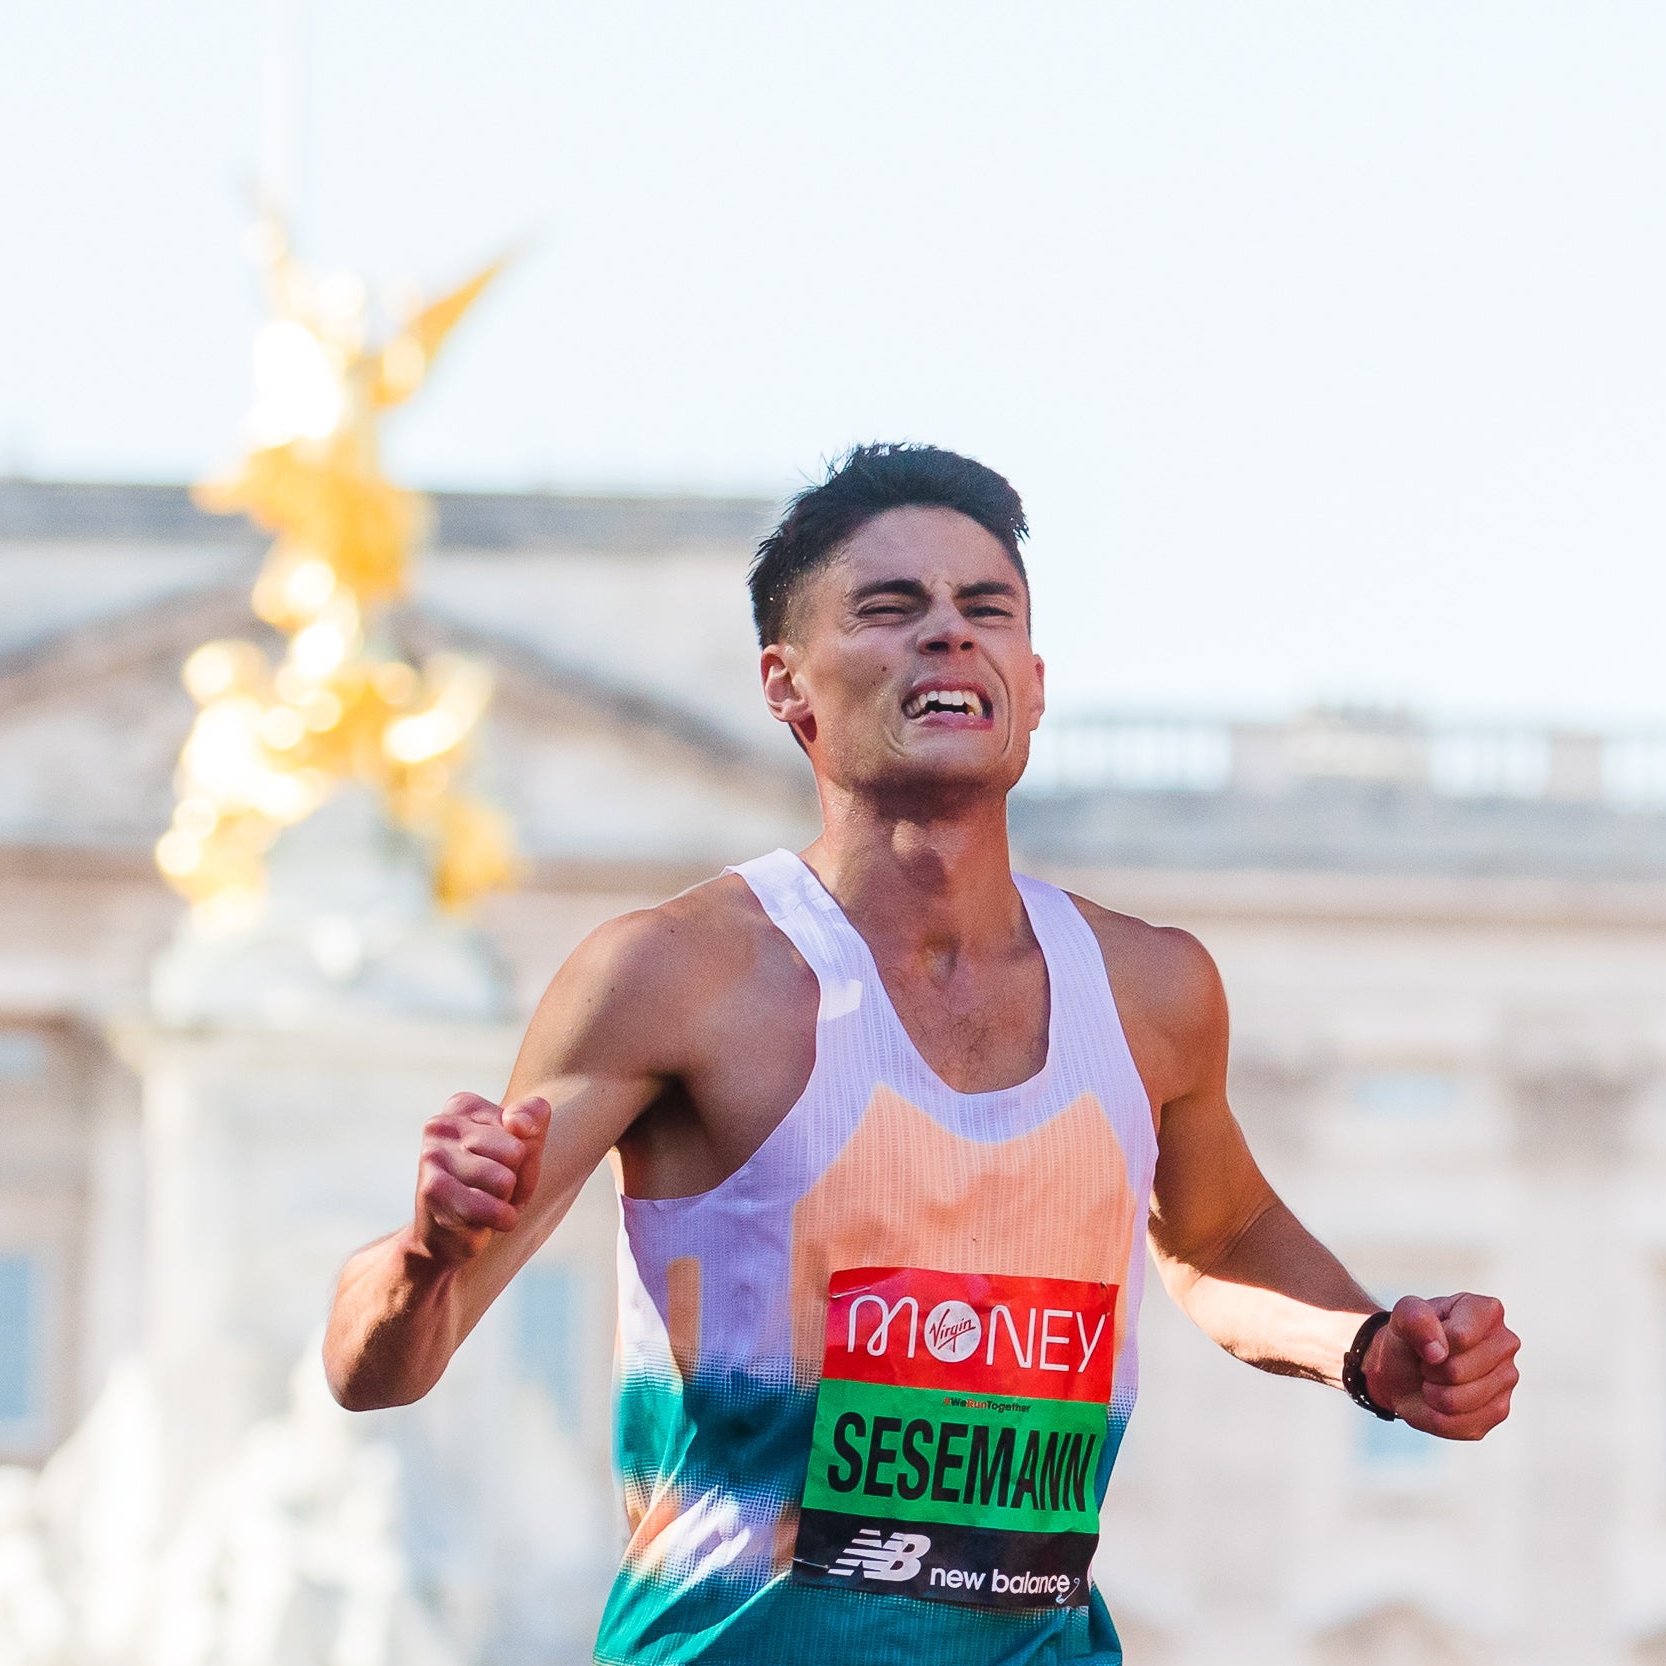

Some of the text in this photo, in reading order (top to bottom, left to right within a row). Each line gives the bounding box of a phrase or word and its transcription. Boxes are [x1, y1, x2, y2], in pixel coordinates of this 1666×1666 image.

[929, 1308, 977, 1353] Virgin
[943, 1397, 1031, 1413] #WeRunTogether
[827, 1411, 1096, 1512] SESEMANN
[929, 1567, 1070, 1594] new balance
